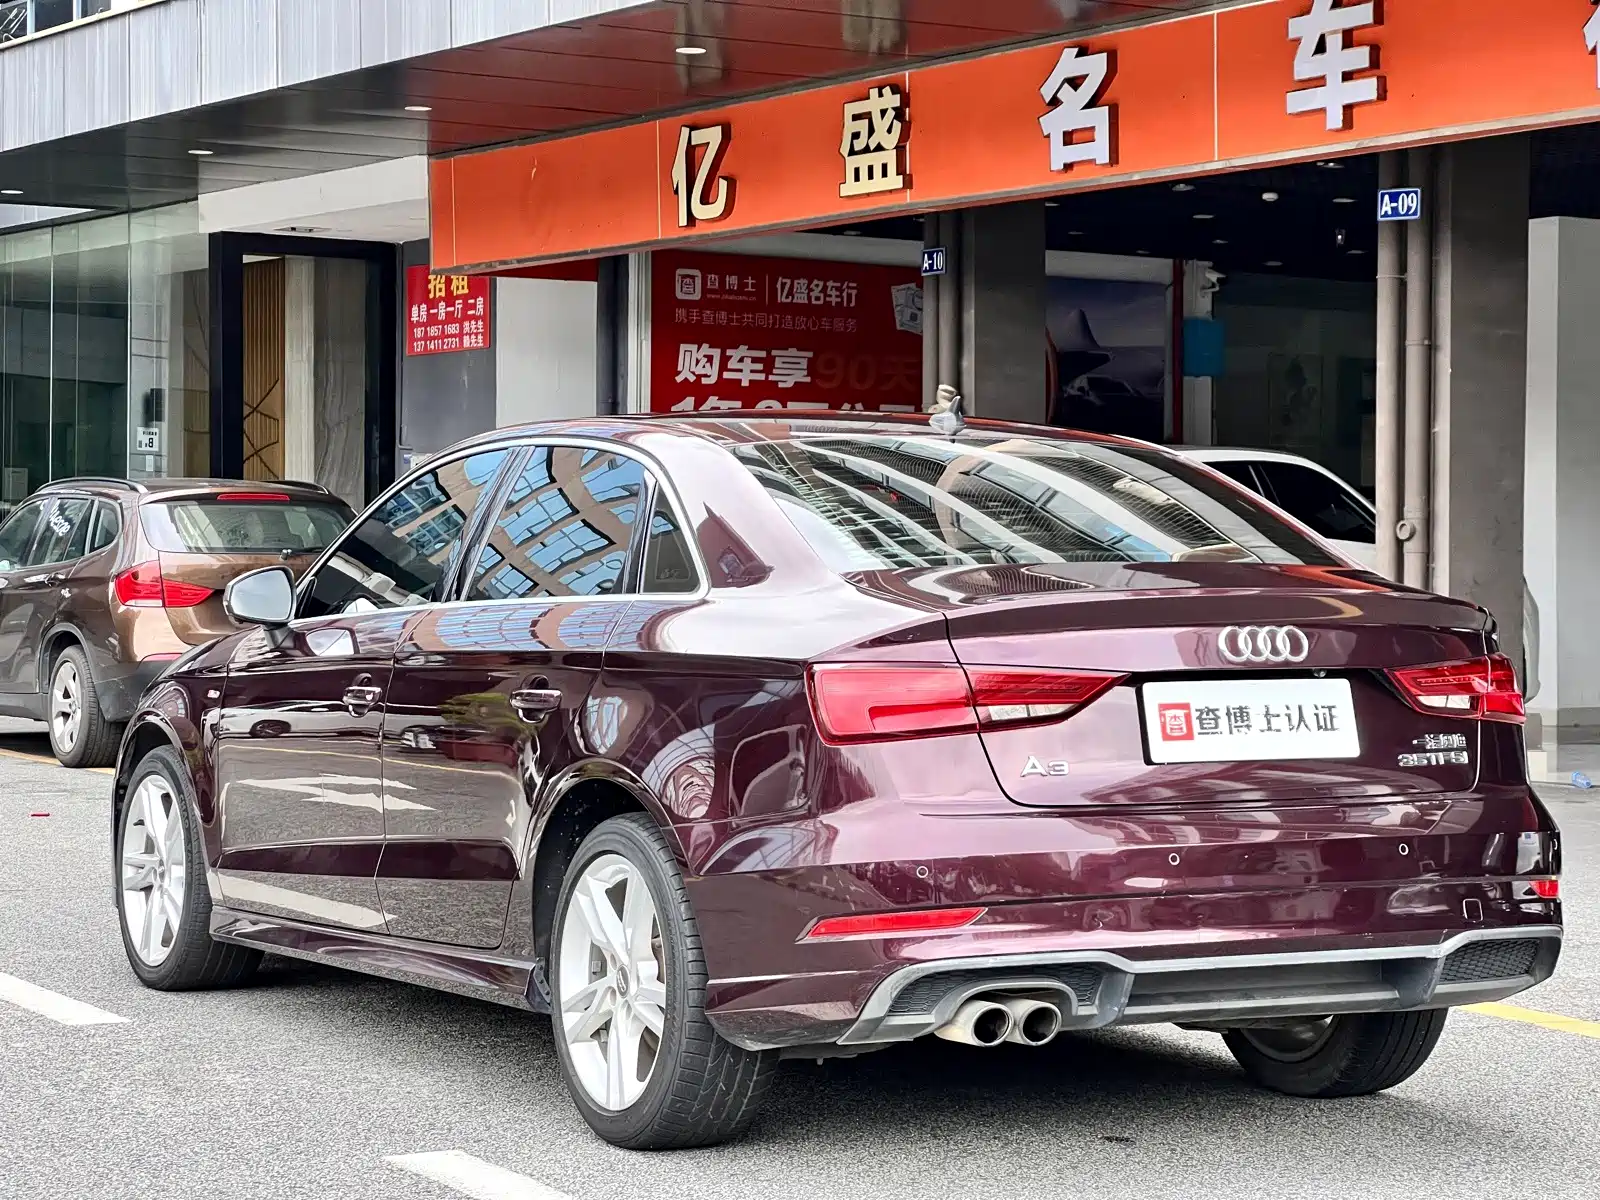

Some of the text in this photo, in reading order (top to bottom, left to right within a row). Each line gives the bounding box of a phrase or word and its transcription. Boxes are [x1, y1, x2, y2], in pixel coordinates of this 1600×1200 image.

[1381, 192, 1418, 216] A-09
[922, 251, 943, 271] A-10
[428, 274, 469, 299] 招租
[706, 274, 756, 292] 查博士
[776, 276, 858, 307] 亿盛名车行
[411, 303, 427, 324] 单房
[467, 296, 484, 316] 二房
[675, 307, 857, 333] 携手查博士共同打造放心车服务
[413, 341, 425, 352] 137
[427, 339, 442, 351] 1411
[443, 337, 459, 350] 2731
[1020, 755, 1069, 777] A3
